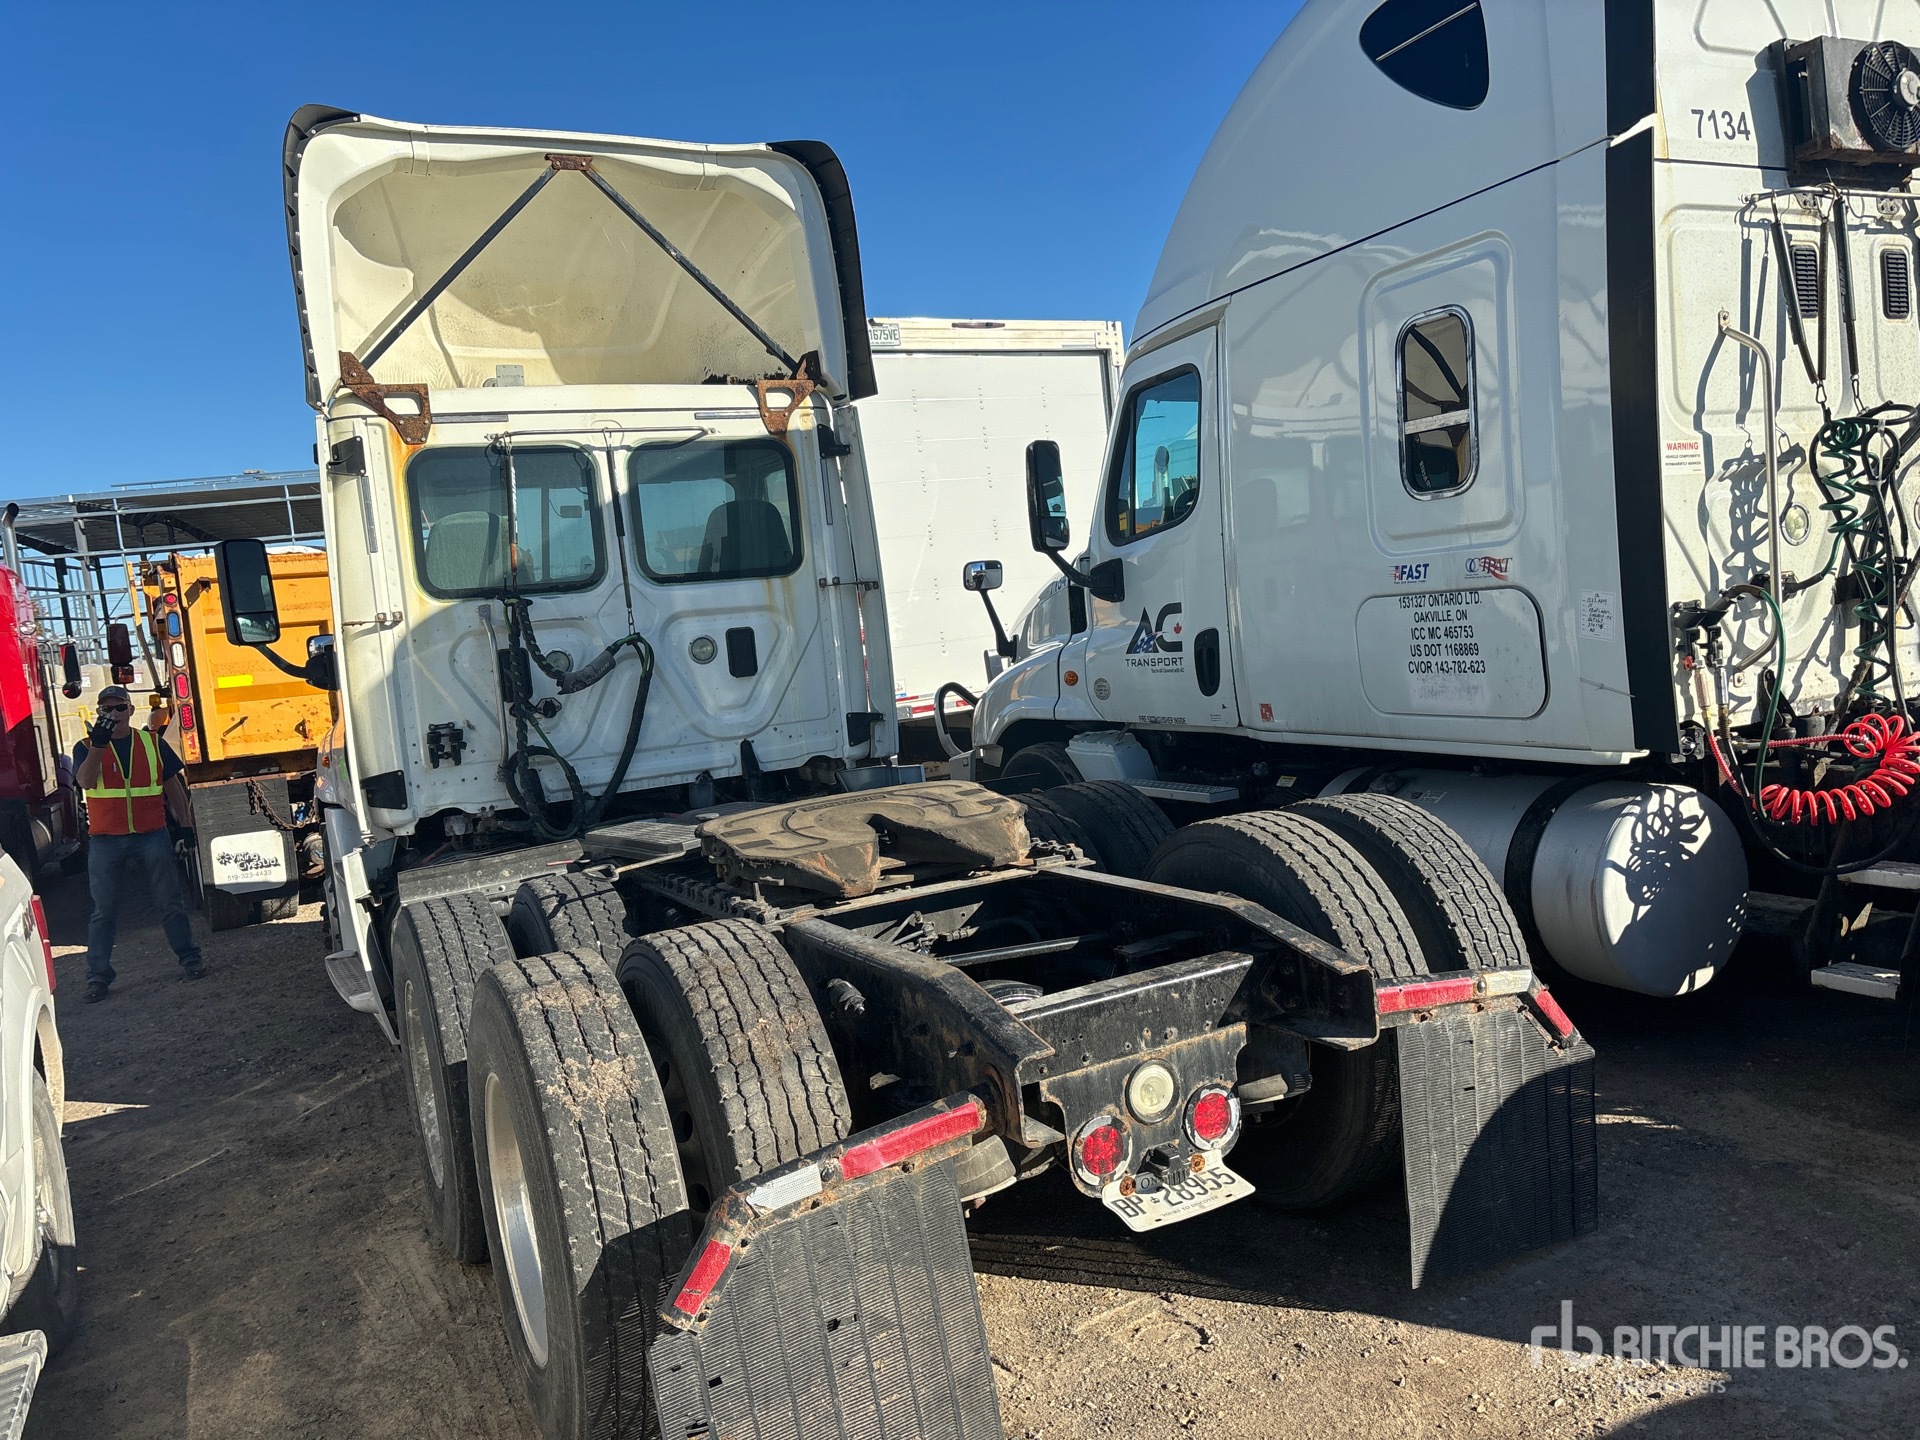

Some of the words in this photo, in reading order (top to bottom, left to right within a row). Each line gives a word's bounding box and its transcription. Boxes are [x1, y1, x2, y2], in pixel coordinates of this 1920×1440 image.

[1690, 108, 1751, 141] 7134
[1666, 441, 1699, 451] WARNING
[1400, 563, 1430, 580] FAST
[1398, 595, 1426, 609] 1531327
[1428, 592, 1463, 607] ONTARIO
[1465, 591, 1482, 605] LTD.
[1413, 610, 1454, 623] OAKVILLE,
[1455, 609, 1468, 621] ON
[1411, 627, 1426, 640] ICC
[1428, 626, 1441, 640] MC
[1443, 625, 1474, 639] 465753
[1410, 643, 1422, 657] US
[1423, 643, 1442, 657] DOT
[1444, 642, 1479, 656] 1168869
[1125, 657, 1183, 667] TRANSPORT
[1408, 660, 1433, 674] CVOR
[1434, 660, 1486, 674] 143-782-623
[1111, 1195, 1147, 1218] BP
[1163, 1166, 1236, 1207] 28955
[1191, 1195, 1219, 1208] DISCOVER
